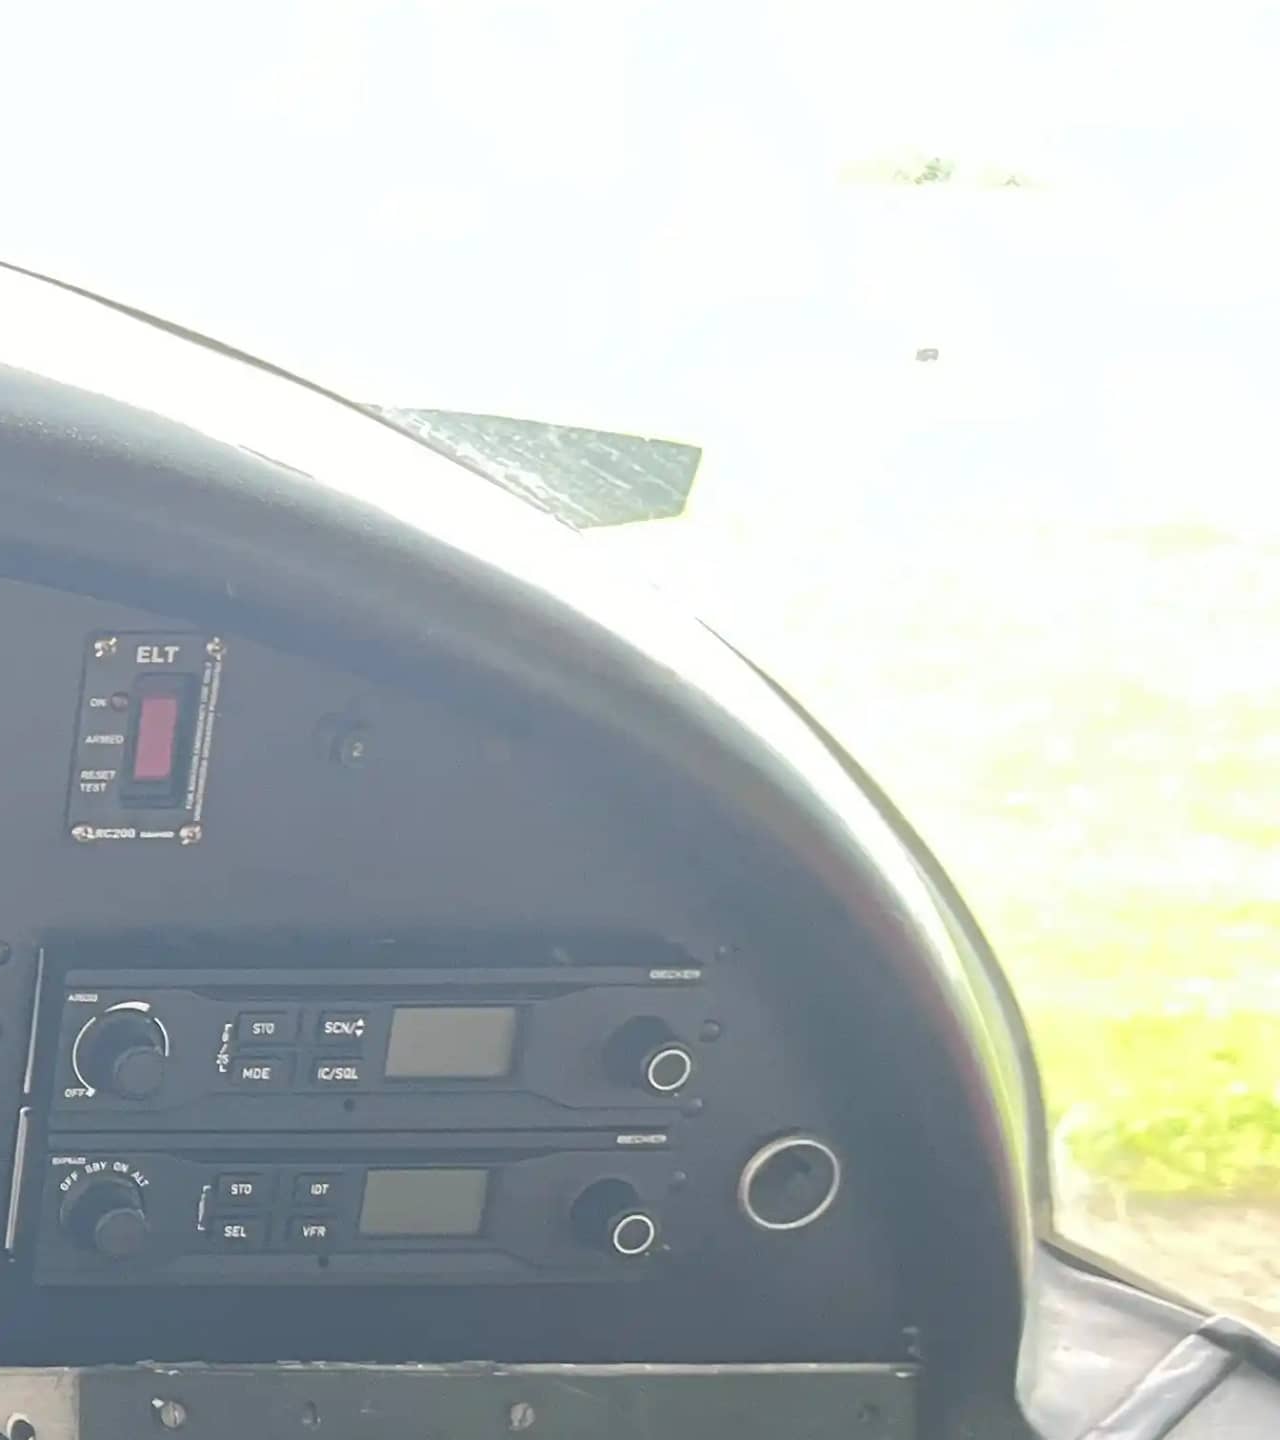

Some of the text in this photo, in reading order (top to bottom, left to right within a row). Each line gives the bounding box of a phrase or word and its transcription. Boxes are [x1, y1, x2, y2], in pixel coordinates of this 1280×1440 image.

[136, 646, 180, 663] ELT
[80, 783, 107, 792] TEST
[252, 1023, 274, 1034] STO
[242, 1068, 271, 1080] MDE
[317, 1068, 358, 1080] IC/SQL
[131, 1171, 150, 1188] ALT
[231, 1184, 252, 1195] STO
[311, 1184, 329, 1195] IDT
[224, 1226, 246, 1237] SEL
[303, 1226, 326, 1237] VFR
